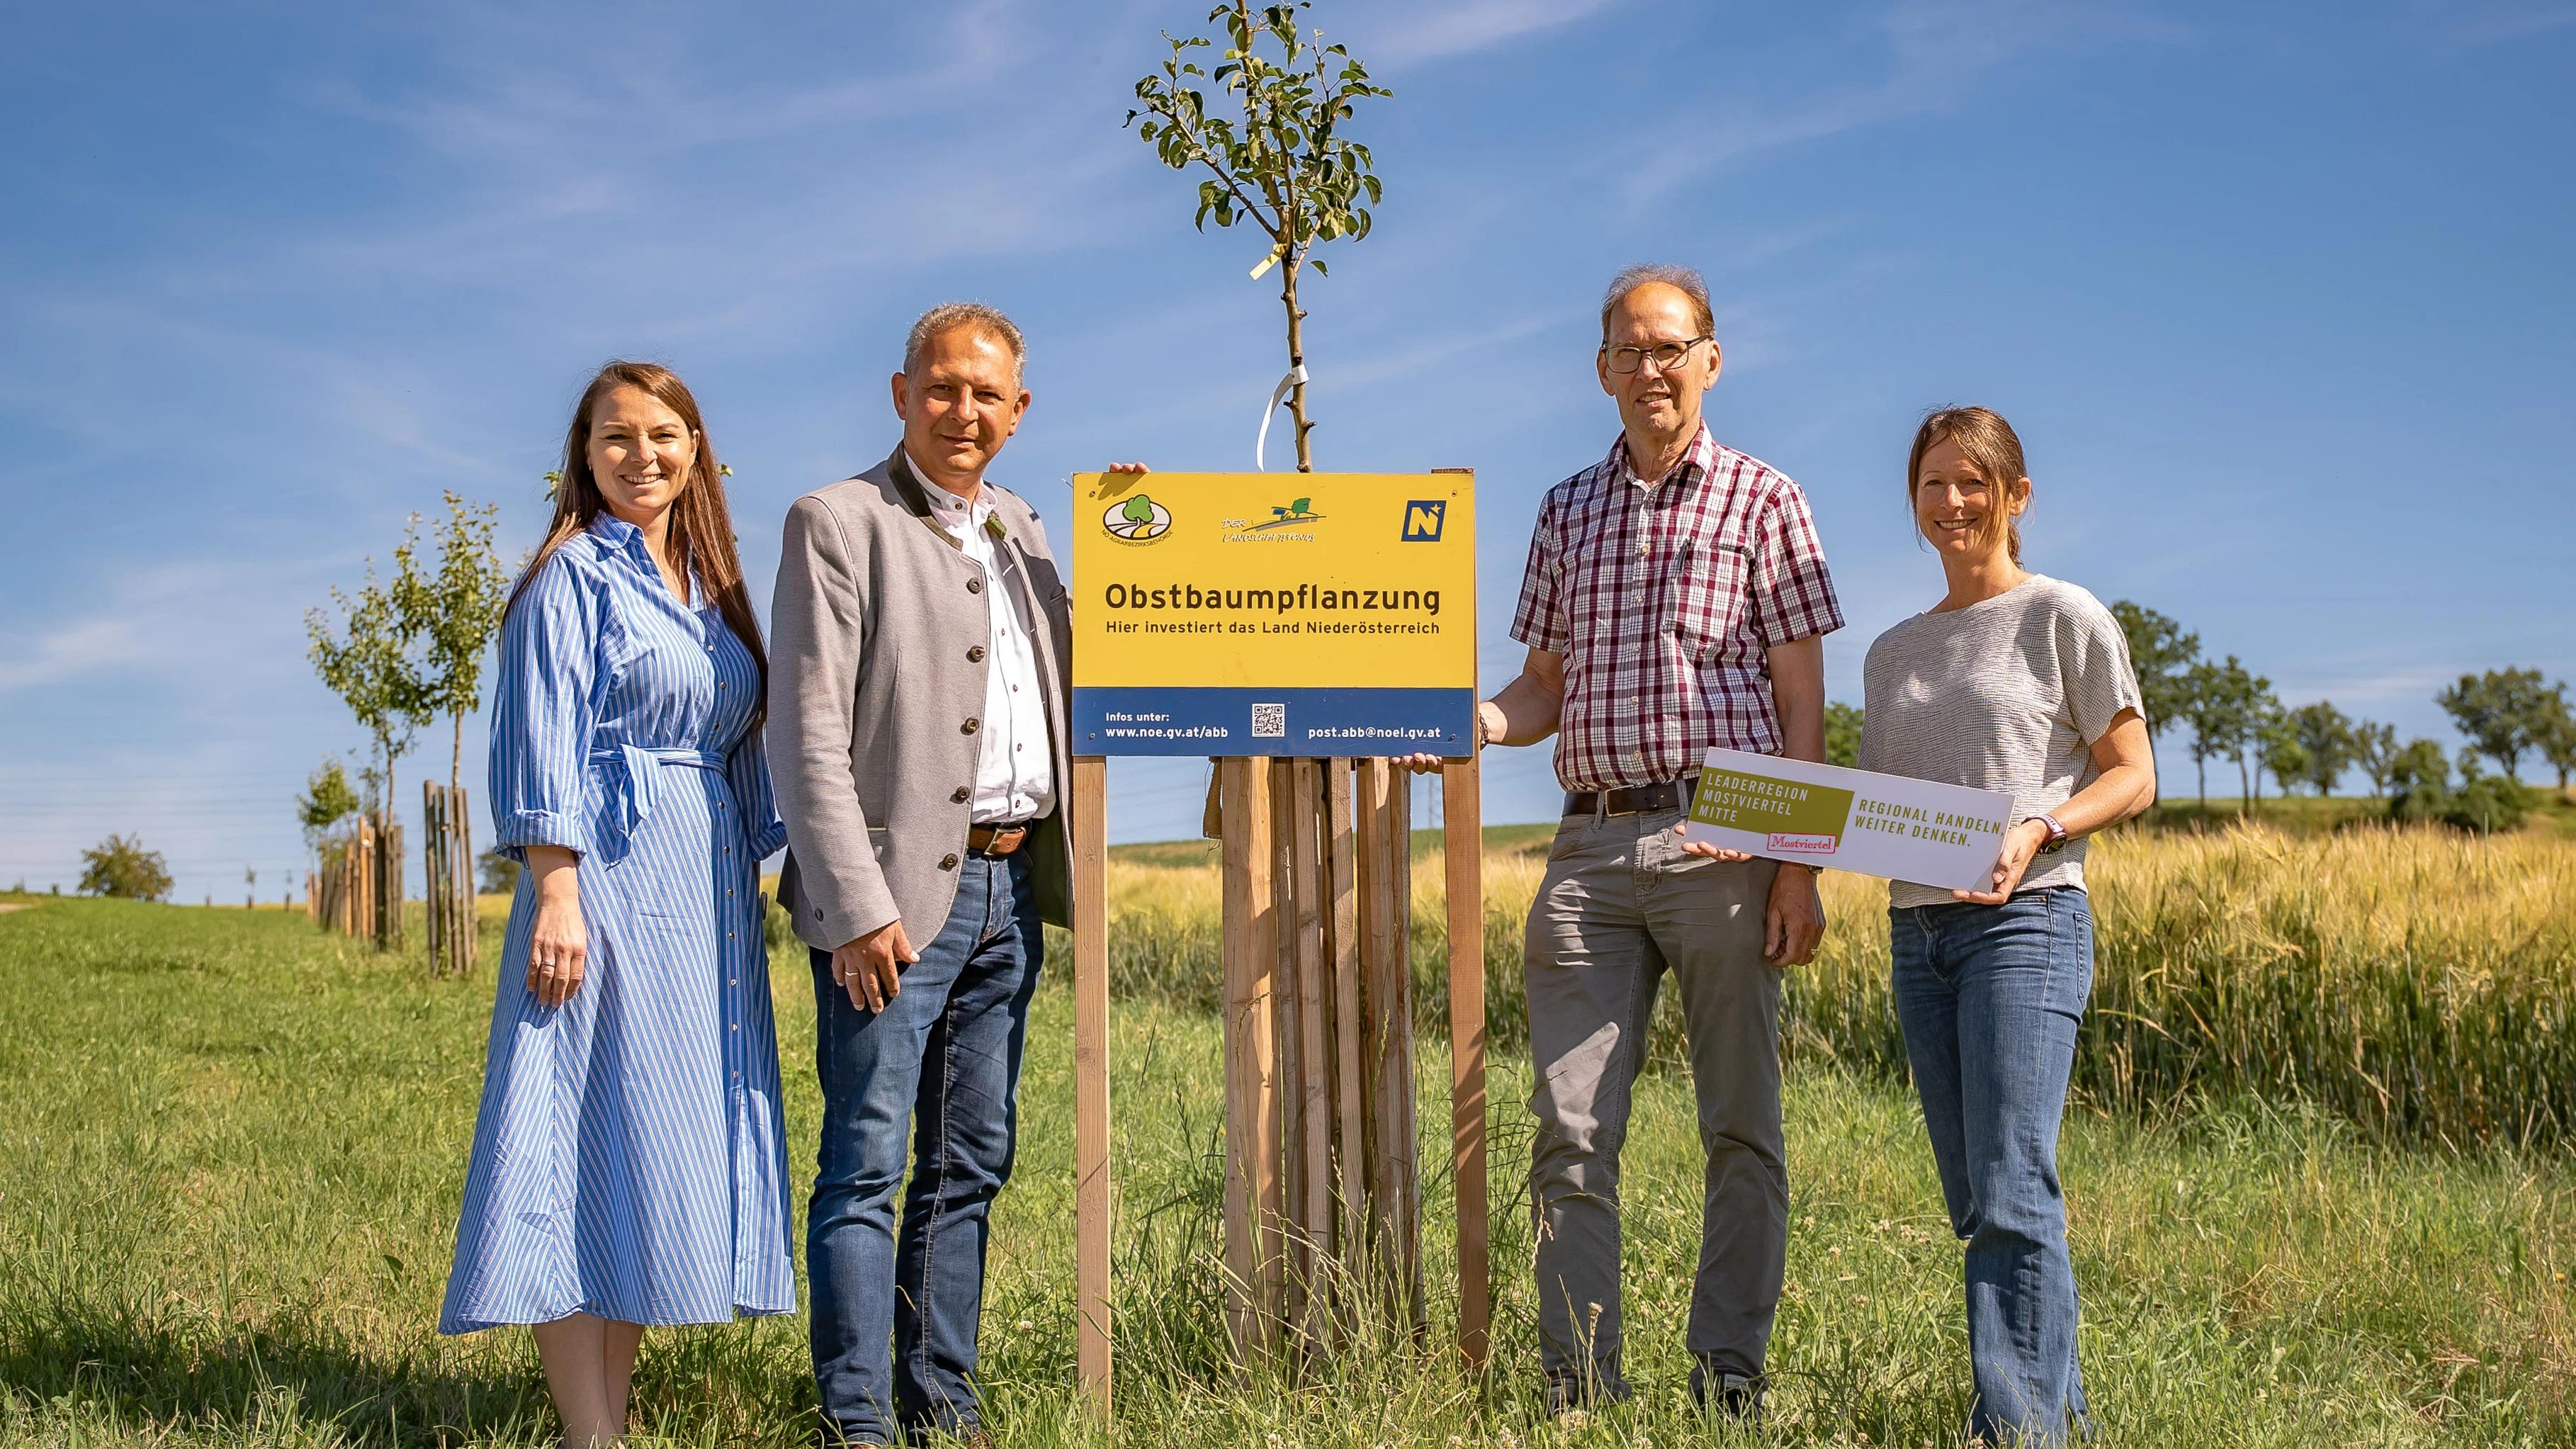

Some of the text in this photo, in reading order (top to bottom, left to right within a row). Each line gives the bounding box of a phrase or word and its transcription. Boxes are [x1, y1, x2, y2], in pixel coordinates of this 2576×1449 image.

[1105, 583, 1440, 616] Obstbaumpflanzung
[1106, 621, 1440, 634] Hier investiert das Land Niederösterreich
[1106, 712, 1170, 721] Infos unter:
[1106, 726, 1228, 740] www.noe.gv.at/abb
[1308, 726, 1441, 740] post.abb@noel.gv.at
[1707, 774, 1808, 801] LEADERREGION
[1703, 789, 1791, 816] MOSTVIERTEL
[1699, 805, 1736, 822] MITTE
[1859, 799, 2004, 837] REGIONAL HANDELN,
[1855, 816, 1971, 847] WEITER DENKEN.
[1771, 835, 1832, 850] Mostviertel
